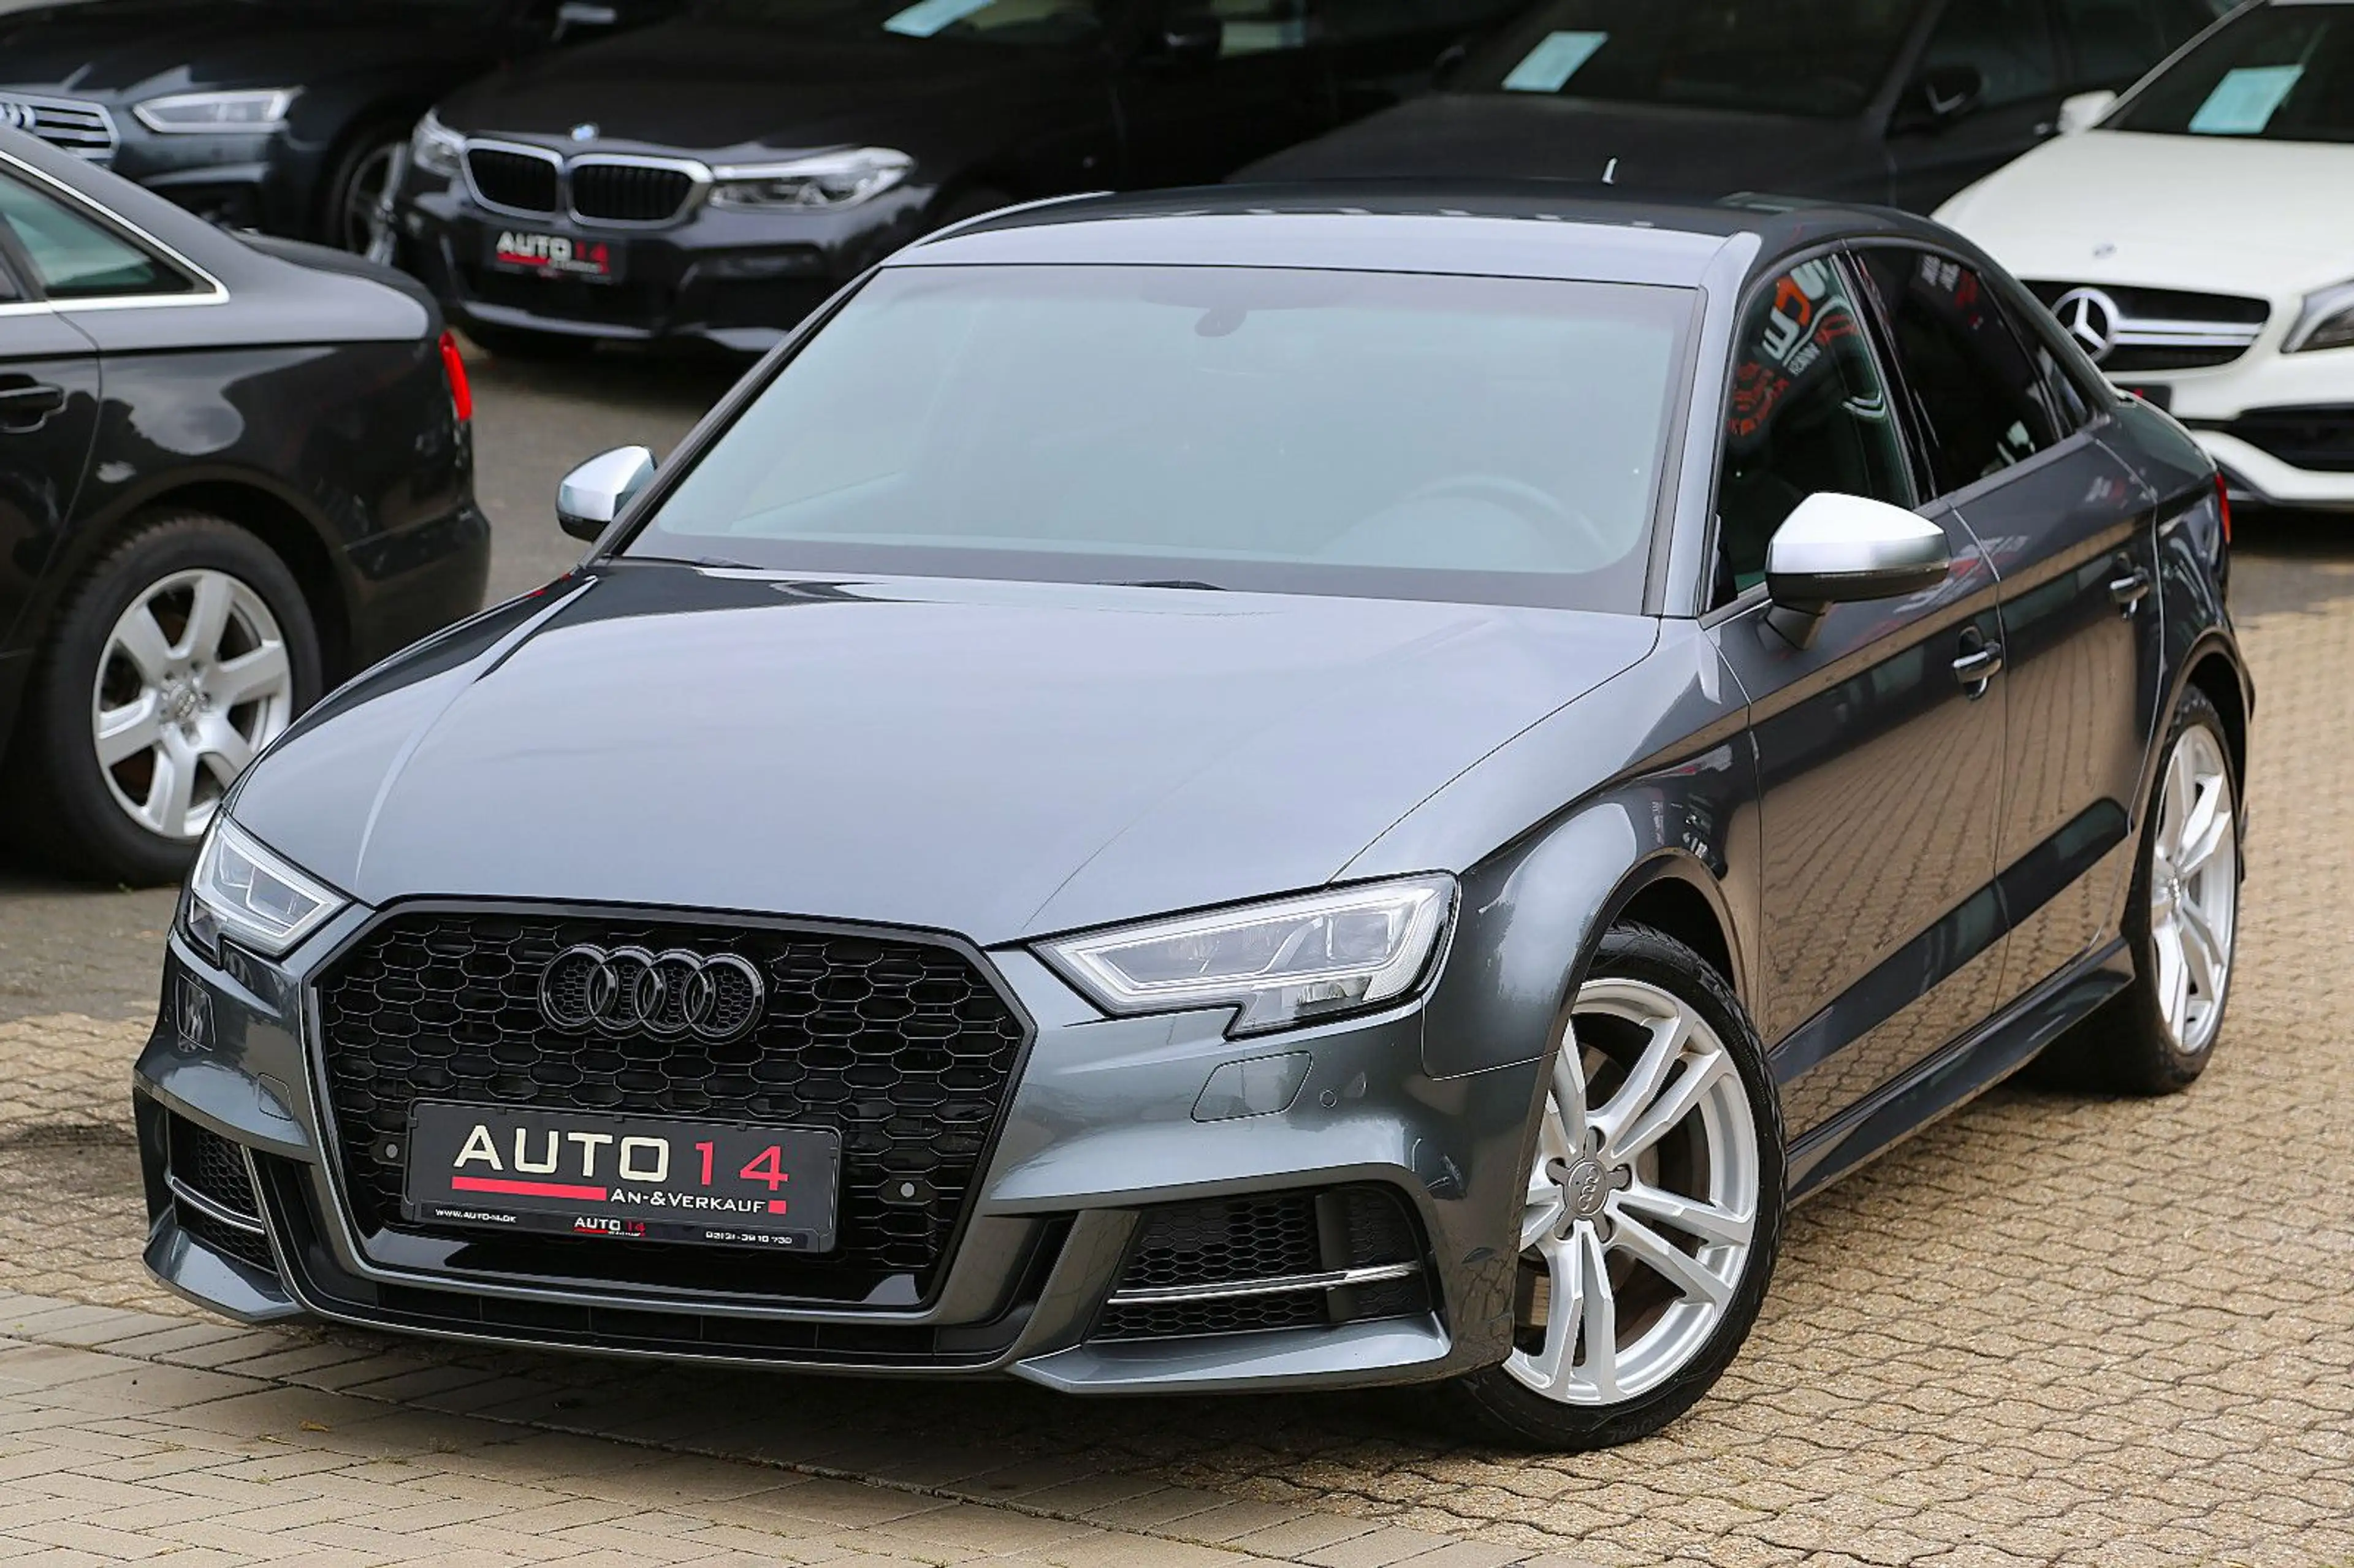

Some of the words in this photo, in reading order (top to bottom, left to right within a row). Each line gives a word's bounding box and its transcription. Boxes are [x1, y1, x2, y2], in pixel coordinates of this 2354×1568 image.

[496, 230, 572, 262] AUTO
[575, 240, 609, 265] 14
[453, 1124, 669, 1182] AUTO
[695, 1141, 790, 1191] 14
[574, 1216, 621, 1231] AUTO
